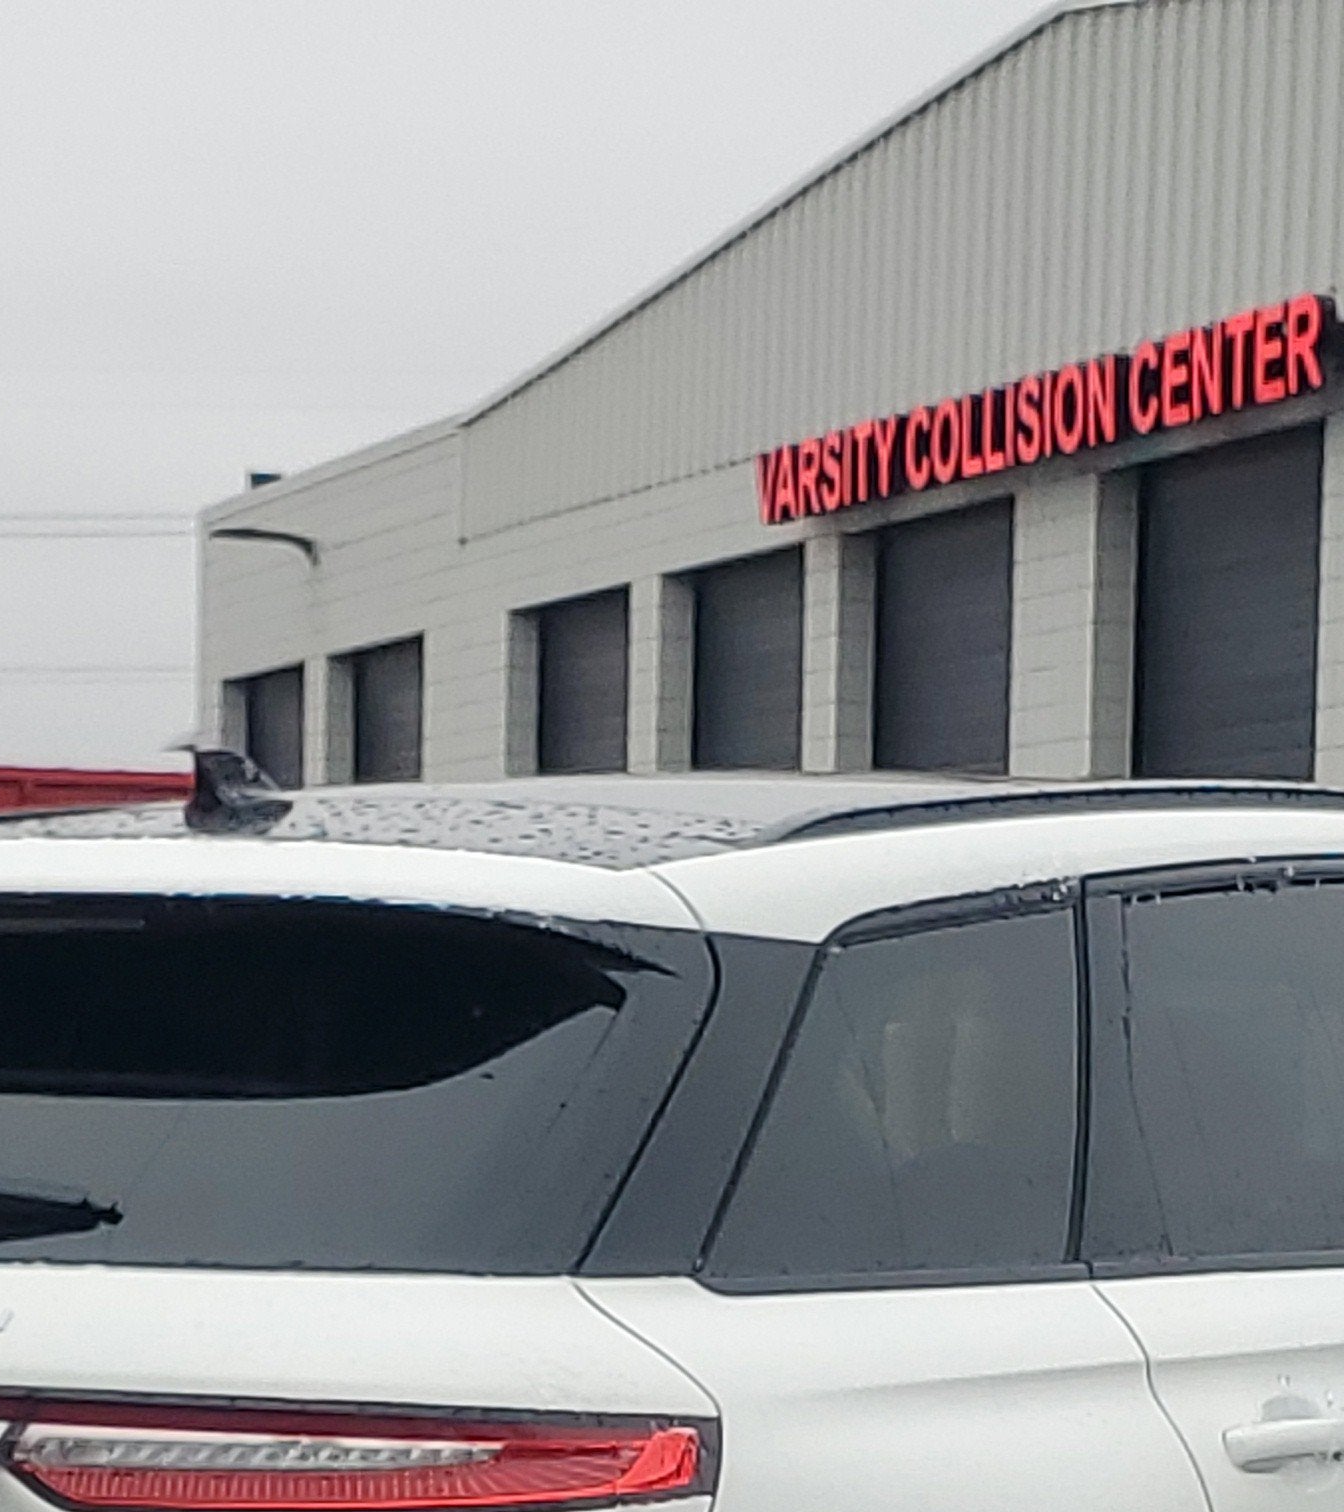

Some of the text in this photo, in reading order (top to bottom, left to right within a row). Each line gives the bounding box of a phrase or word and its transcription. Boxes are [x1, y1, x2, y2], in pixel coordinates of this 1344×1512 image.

[757, 293, 1323, 525] VARSITY COLLISION CENTER
